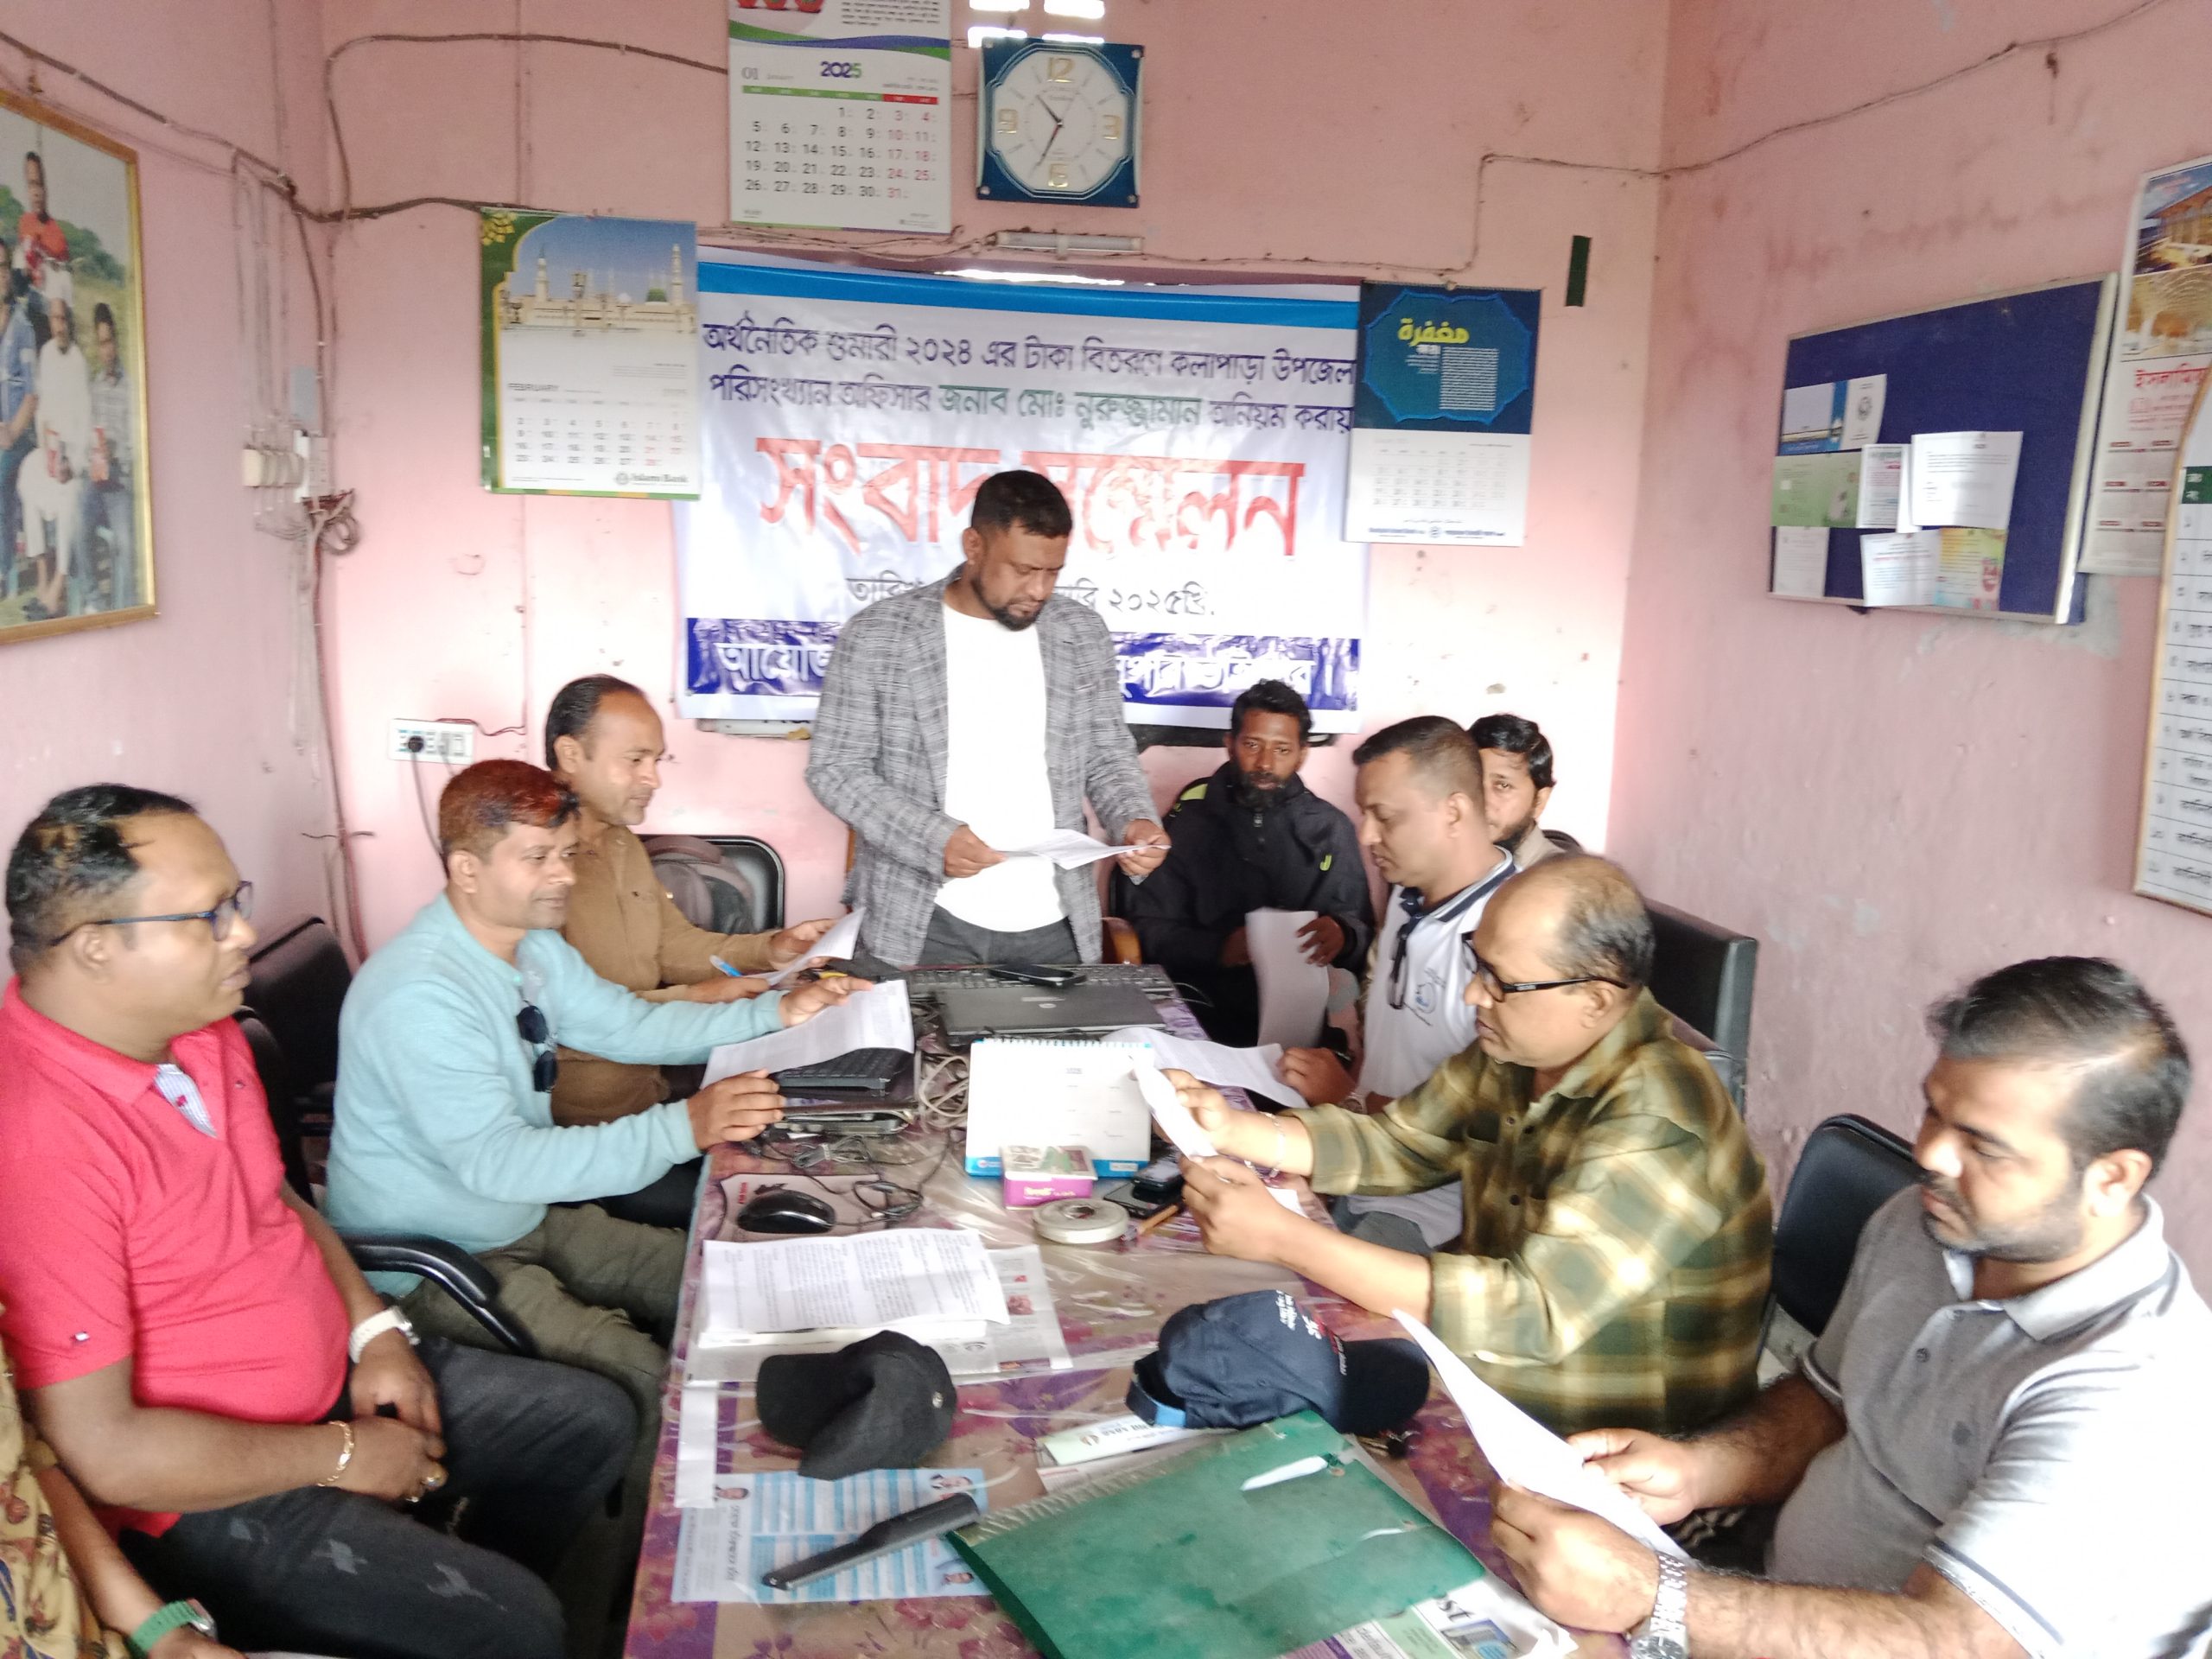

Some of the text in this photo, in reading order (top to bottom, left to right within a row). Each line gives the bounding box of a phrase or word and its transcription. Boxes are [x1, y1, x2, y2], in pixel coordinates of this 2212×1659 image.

[742, 67, 759, 80] 01
[820, 61, 862, 79] 2025
[1047, 58, 1074, 82] 12
[839, 107, 930, 122] 1 2 3 4
[997, 109, 1018, 134] 9
[1104, 114, 1121, 139] 3
[753, 122, 929, 141] 5 6 7 8 9 10 11
[746, 141, 930, 161] 12 13 14 15 16 17 18
[746, 161, 930, 181] 19 20 21 22 23 24 25
[1048, 163, 1069, 188] 6
[746, 180, 901, 198] 26 27 28 29 30 31
[1398, 318, 1470, 346] مغفرة
[702, 311, 817, 353] অর্থনৈতিক
[827, 323, 897, 360] শুমারী
[906, 337, 972, 365] ২০২৪
[982, 340, 1017, 367] এর
[1025, 335, 1073, 371] টাকা
[1171, 351, 1265, 385] কলাপাড়া
[709, 364, 831, 408] পরিসংখ্যান
[838, 372, 931, 412] অফিসার
[939, 385, 1009, 416] জনাব
[1019, 389, 1065, 418] মোঃ
[1209, 391, 1288, 430] অনিয়ম
[1294, 404, 1354, 434] করায়
[755, 437, 1000, 556] সংবাদ
